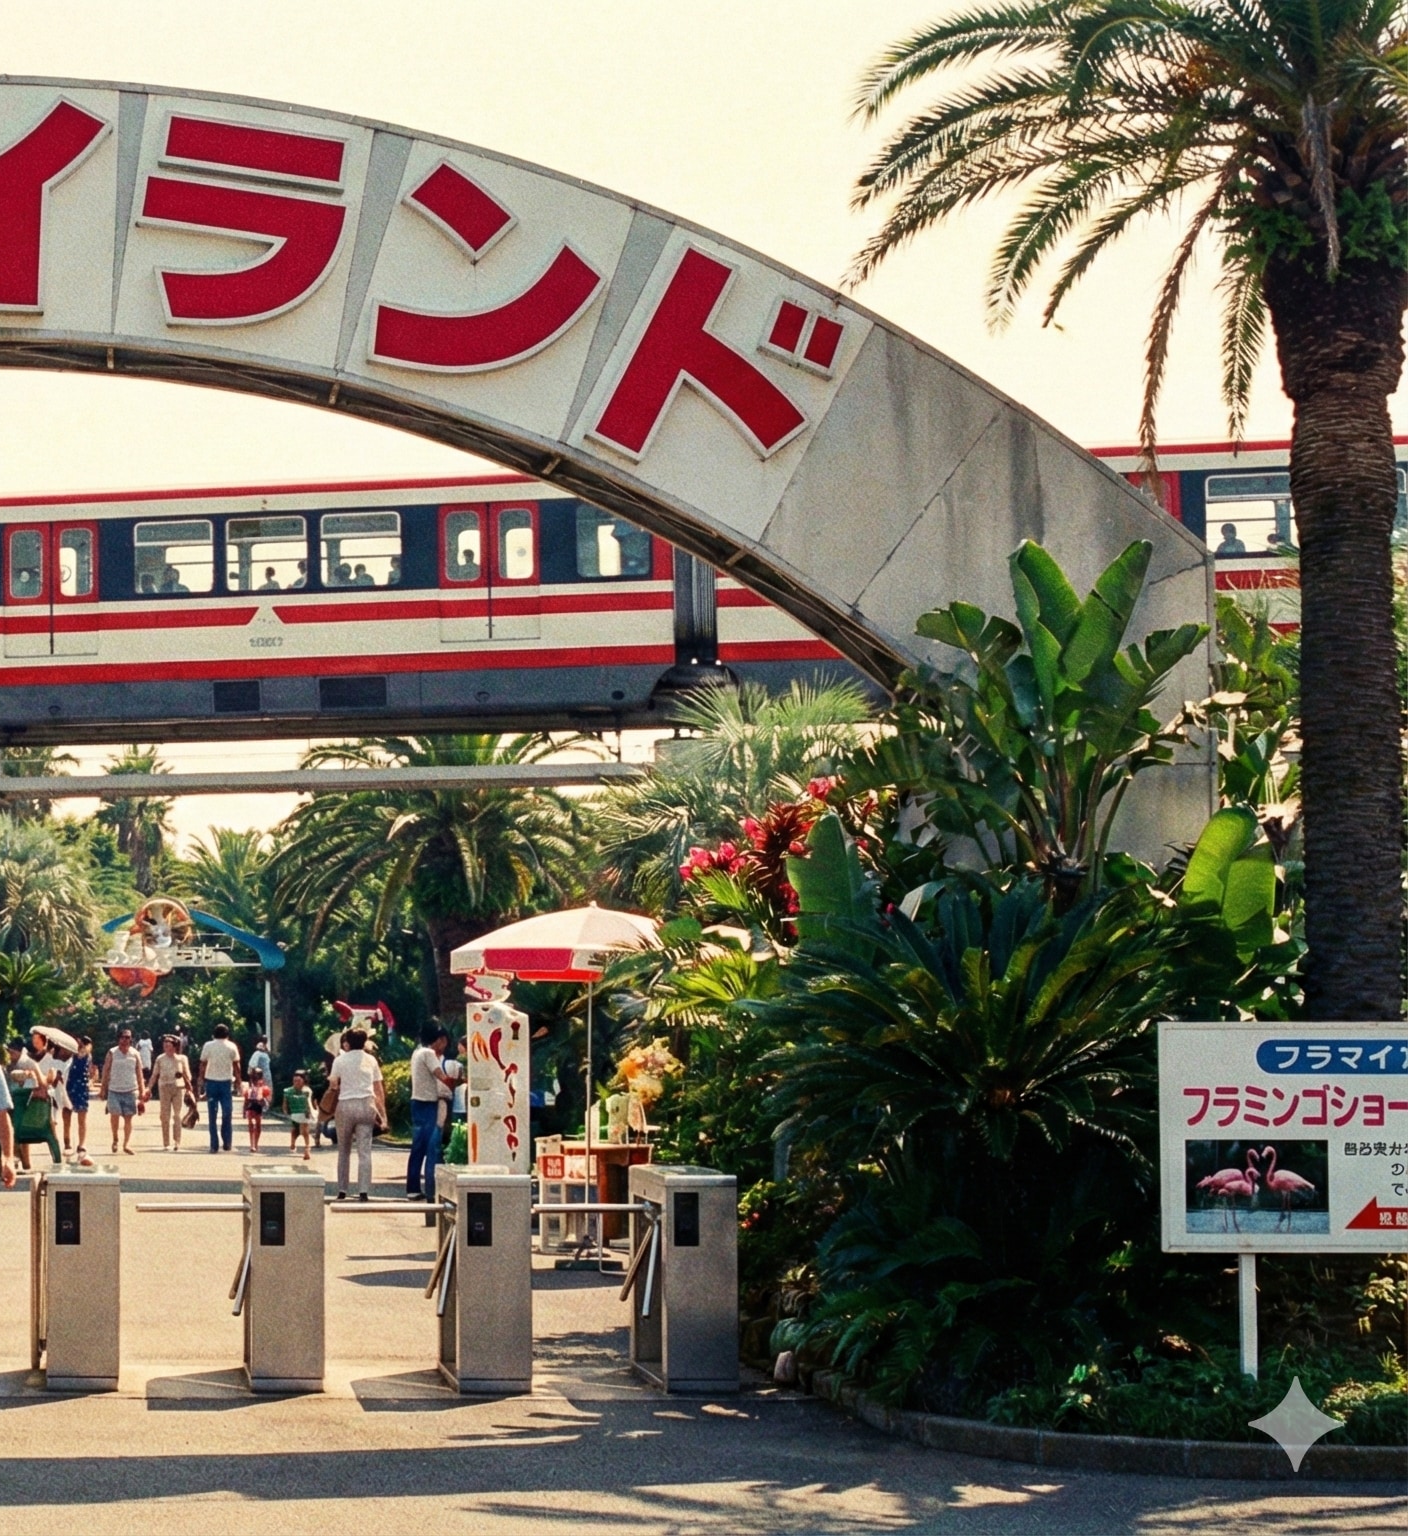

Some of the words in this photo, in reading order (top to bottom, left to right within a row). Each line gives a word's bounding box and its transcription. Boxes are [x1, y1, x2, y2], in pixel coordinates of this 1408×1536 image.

[1183, 1084, 1408, 1127] フラミンゴショー
